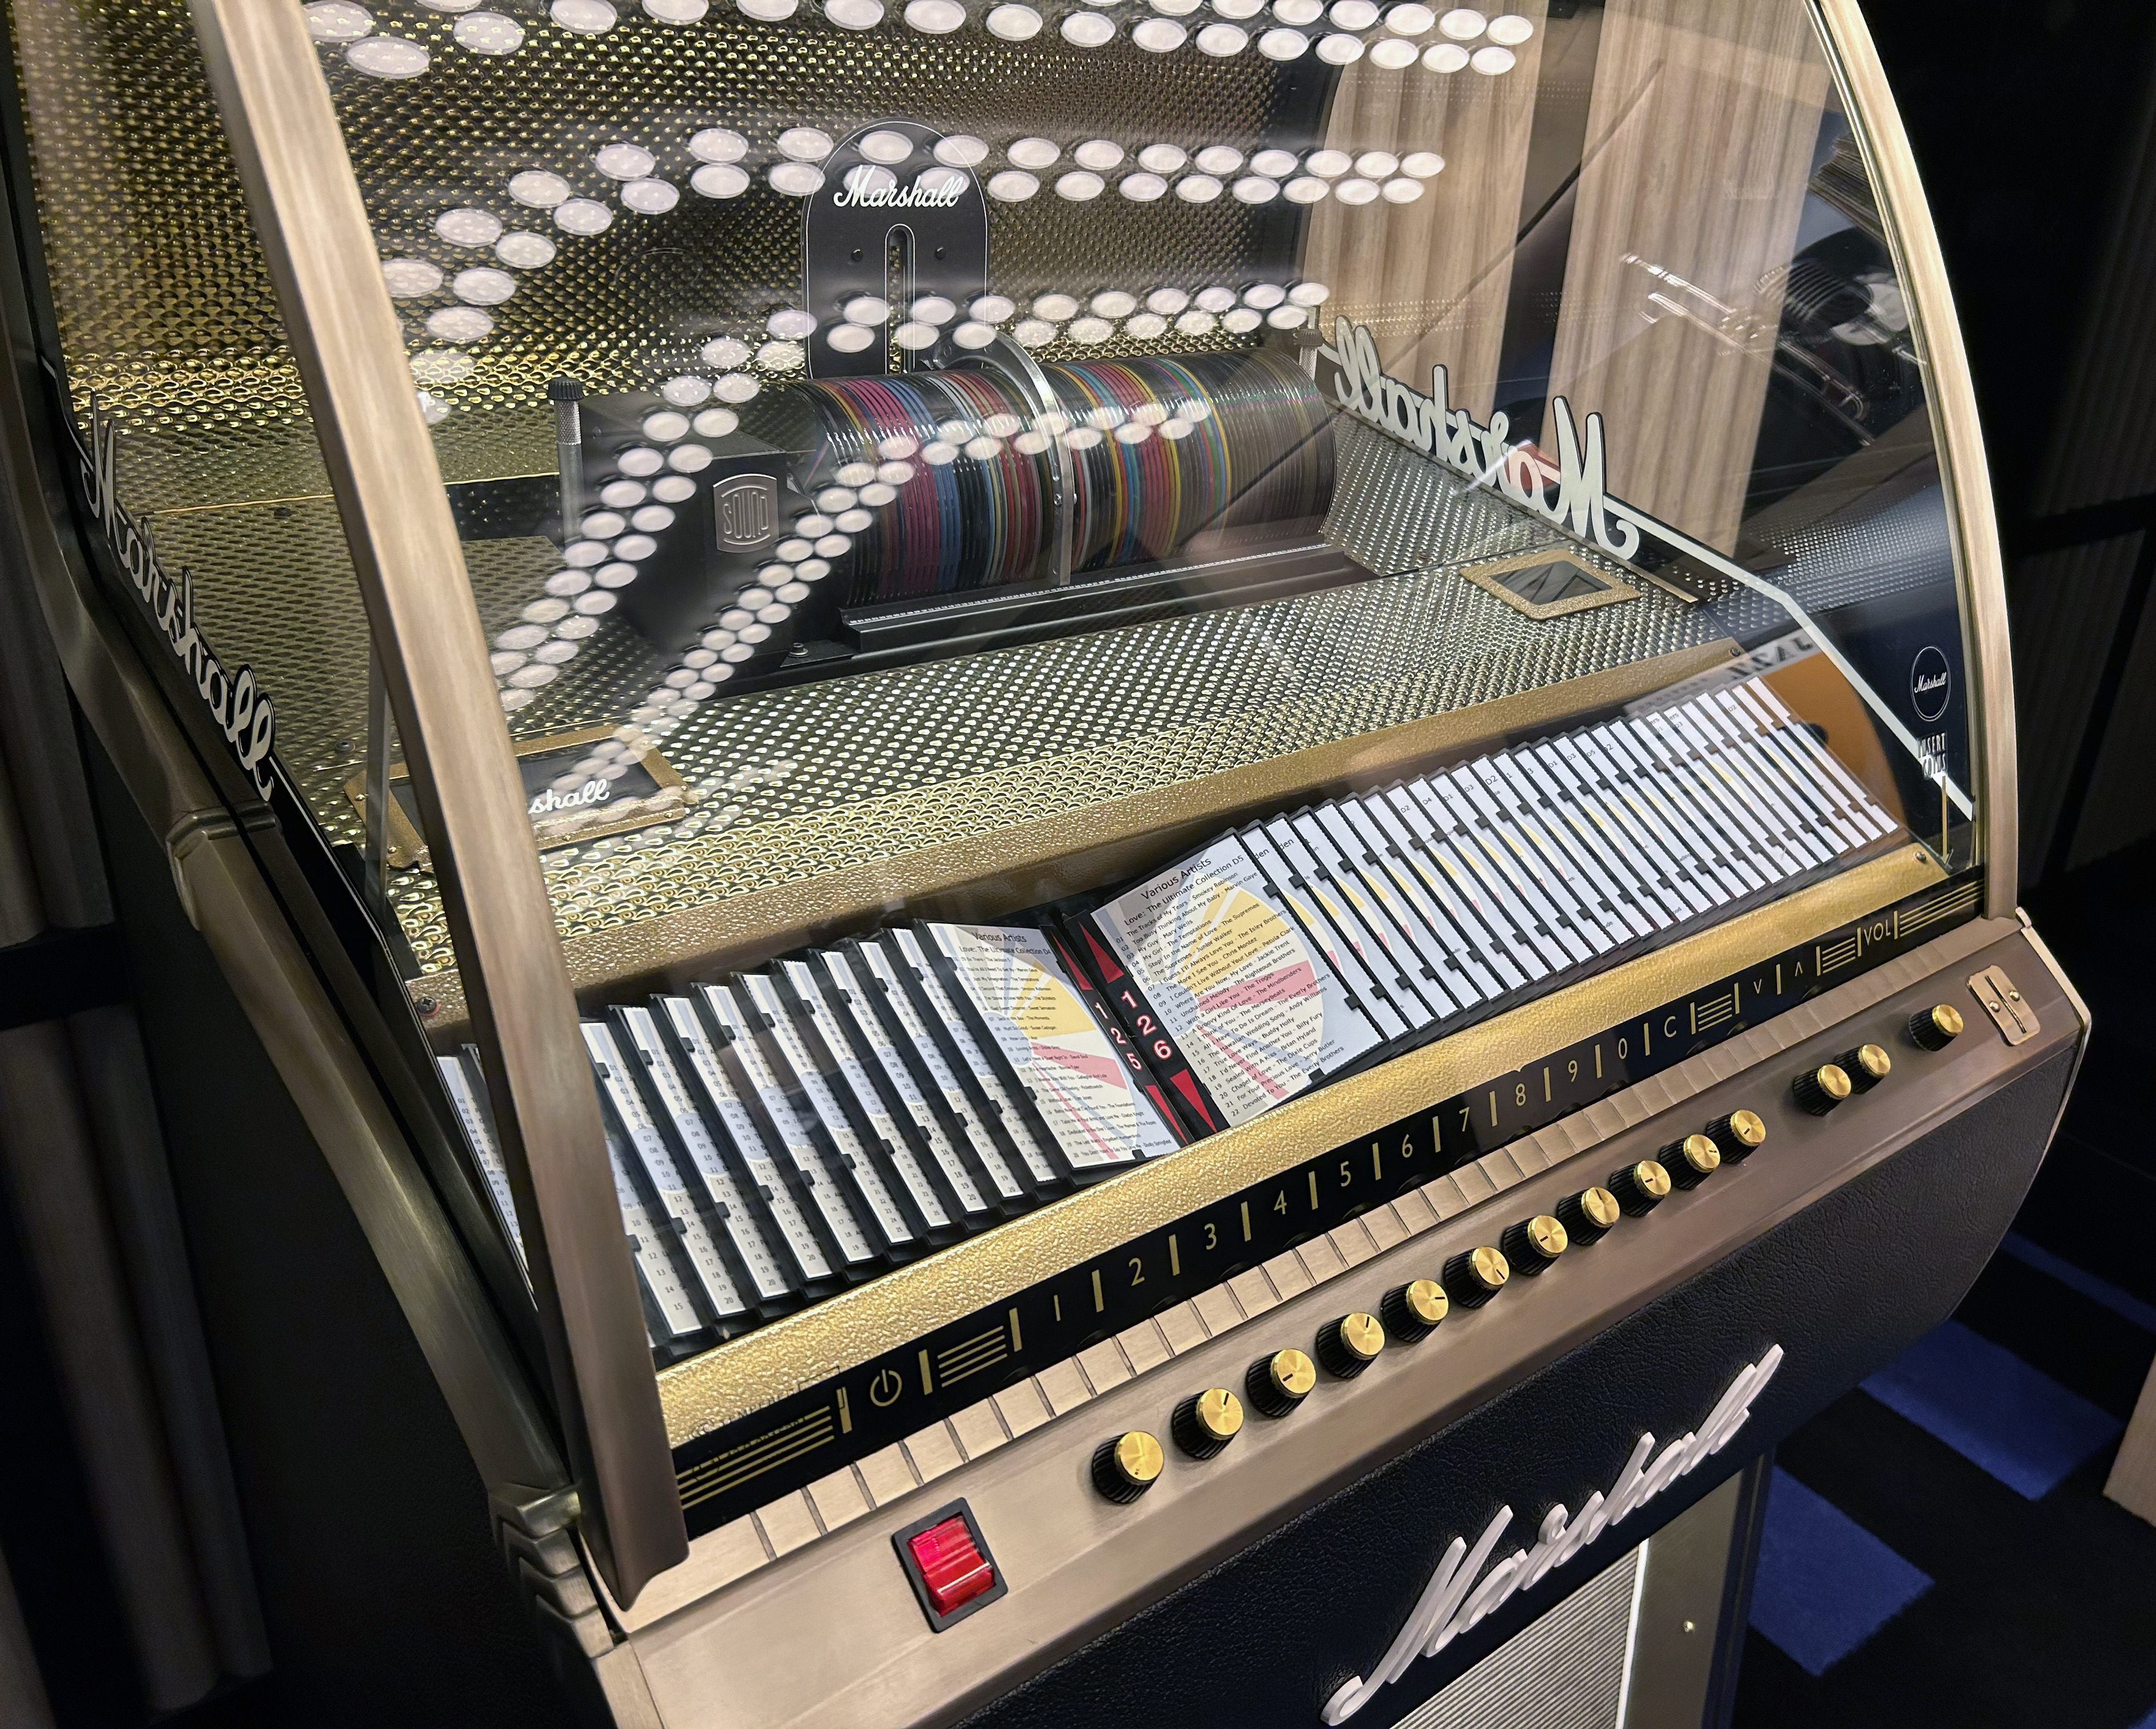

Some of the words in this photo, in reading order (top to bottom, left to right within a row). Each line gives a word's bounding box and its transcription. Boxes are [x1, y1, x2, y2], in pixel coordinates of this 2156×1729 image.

[833, 165, 964, 208] Marshall
[80, 390, 275, 802] Marshall
[1914, 671, 1947, 694] Marshall
[1728, 704, 1737, 712] D2
[1567, 753, 1576, 761] D3
[1916, 732, 1946, 759] INSERT
[1548, 760, 1559, 768] D1
[1922, 752, 1946, 779] COINS
[1464, 784, 1474, 792] D3
[1485, 775, 1499, 786] D2
[528, 779, 610, 814] shall
[1400, 805, 1411, 813] D2
[1422, 797, 1433, 805] D4
[1442, 794, 1454, 802] D1
[1124, 911, 1146, 925] Love:
[1146, 902, 1161, 912] The
[1162, 884, 1194, 903] Ultimate
[1195, 863, 1232, 885] Collection
[1231, 854, 1244, 865] D5
[1141, 877, 1178, 899] Various
[1181, 859, 1211, 879] Artists
[1115, 935, 1124, 944] 01
[1138, 918, 1157, 930] Tracks
[1156, 913, 1163, 921] of
[1162, 909, 1172, 917] My
[1171, 901, 1188, 911] Tears
[1192, 886, 1213, 900] Smokey
[1121, 944, 1130, 952] 02
[1143, 929, 1157, 939] Busy
[1182, 906, 1198, 917] About
[1206, 893, 1220, 903] Baby
[1224, 881, 1243, 893] Marvin
[1243, 872, 1257, 882] Gaye
[972, 933, 1002, 941] Various
[1003, 934, 1027, 942] Artists
[1126, 951, 1135, 960] 03
[1137, 946, 1147, 954] My
[1147, 939, 1158, 947] Guy
[1162, 929, 1177, 938] Mary
[1177, 919, 1193, 930] Wells
[1864, 919, 1891, 945] VOL
[1131, 959, 1140, 968] 04
[1142, 953, 1152, 961] My
[1152, 946, 1163, 955] Girl
[1136, 967, 1145, 975] 05
[1148, 958, 1163, 969] Stop!
[1181, 939, 1197, 949] Name
[1197, 933, 1204, 941] of
[1203, 927, 1217, 937] Love
[1141, 975, 1151, 983] 06
[1196, 940, 1213, 952] Junior
[1213, 929, 1232, 942] Walker
[1147, 983, 1155, 992] 07
[1163, 970, 1181, 982] Guess
[1180, 965, 1189, 973] I'll
[1190, 954, 1209, 967] Always
[1209, 946, 1223, 956] Love
[1237, 931, 1249, 939] The
[1249, 923, 1263, 933] Isley
[1163, 1007, 1172, 1016] 10
[1175, 997, 1194, 1009] Where
[1194, 990, 1204, 998] Are
[1215, 977, 1230, 985] Now,
[1229, 969, 1239, 978] My
[1238, 962, 1253, 972] Love
[1257, 950, 1274, 961] Jackie
[1273, 941, 1289, 951] Trent
[1174, 1024, 1183, 1033] 12
[1186, 1015, 1200, 1025] With
[1205, 1005, 1216, 1014] Girl
[1216, 999, 1228, 1008] Like
[1228, 992, 1240, 1000] You
[1254, 972, 1274, 984] Troggs
[1191, 1049, 1200, 1057] 15
[1215, 1032, 1230, 1042] Have
[1238, 1022, 1248, 1030] Do
[1254, 1007, 1273, 1019] Dream
[1288, 987, 1306, 999] Everly
[1664, 1015, 1677, 1038] C
[1202, 1065, 1210, 1074] 17
[1214, 1057, 1228, 1066] True
[1227, 1049, 1242, 1058] Love
[1242, 1039, 1258, 1050] Ways
[1261, 1026, 1279, 1038] Buddy
[1279, 1017, 1294, 1028] Holly
[1618, 1038, 1628, 1059] 0
[1568, 1060, 1578, 1082] 9
[1230, 1108, 1240, 1117] 22
[1274, 1082, 1286, 1090] You
[1290, 1072, 1301, 1080] The
[1301, 1061, 1320, 1074] Everly
[1515, 1083, 1527, 1106] 8
[1459, 1107, 1470, 1132] 7
[1402, 1134, 1413, 1158] 6
[1340, 1161, 1351, 1187] 5
[1274, 1190, 1287, 1215] 4
[1204, 1224, 1217, 1250] 3
[1129, 1258, 1145, 1285] 2
[1321, 1344, 1784, 1726] Marshall
